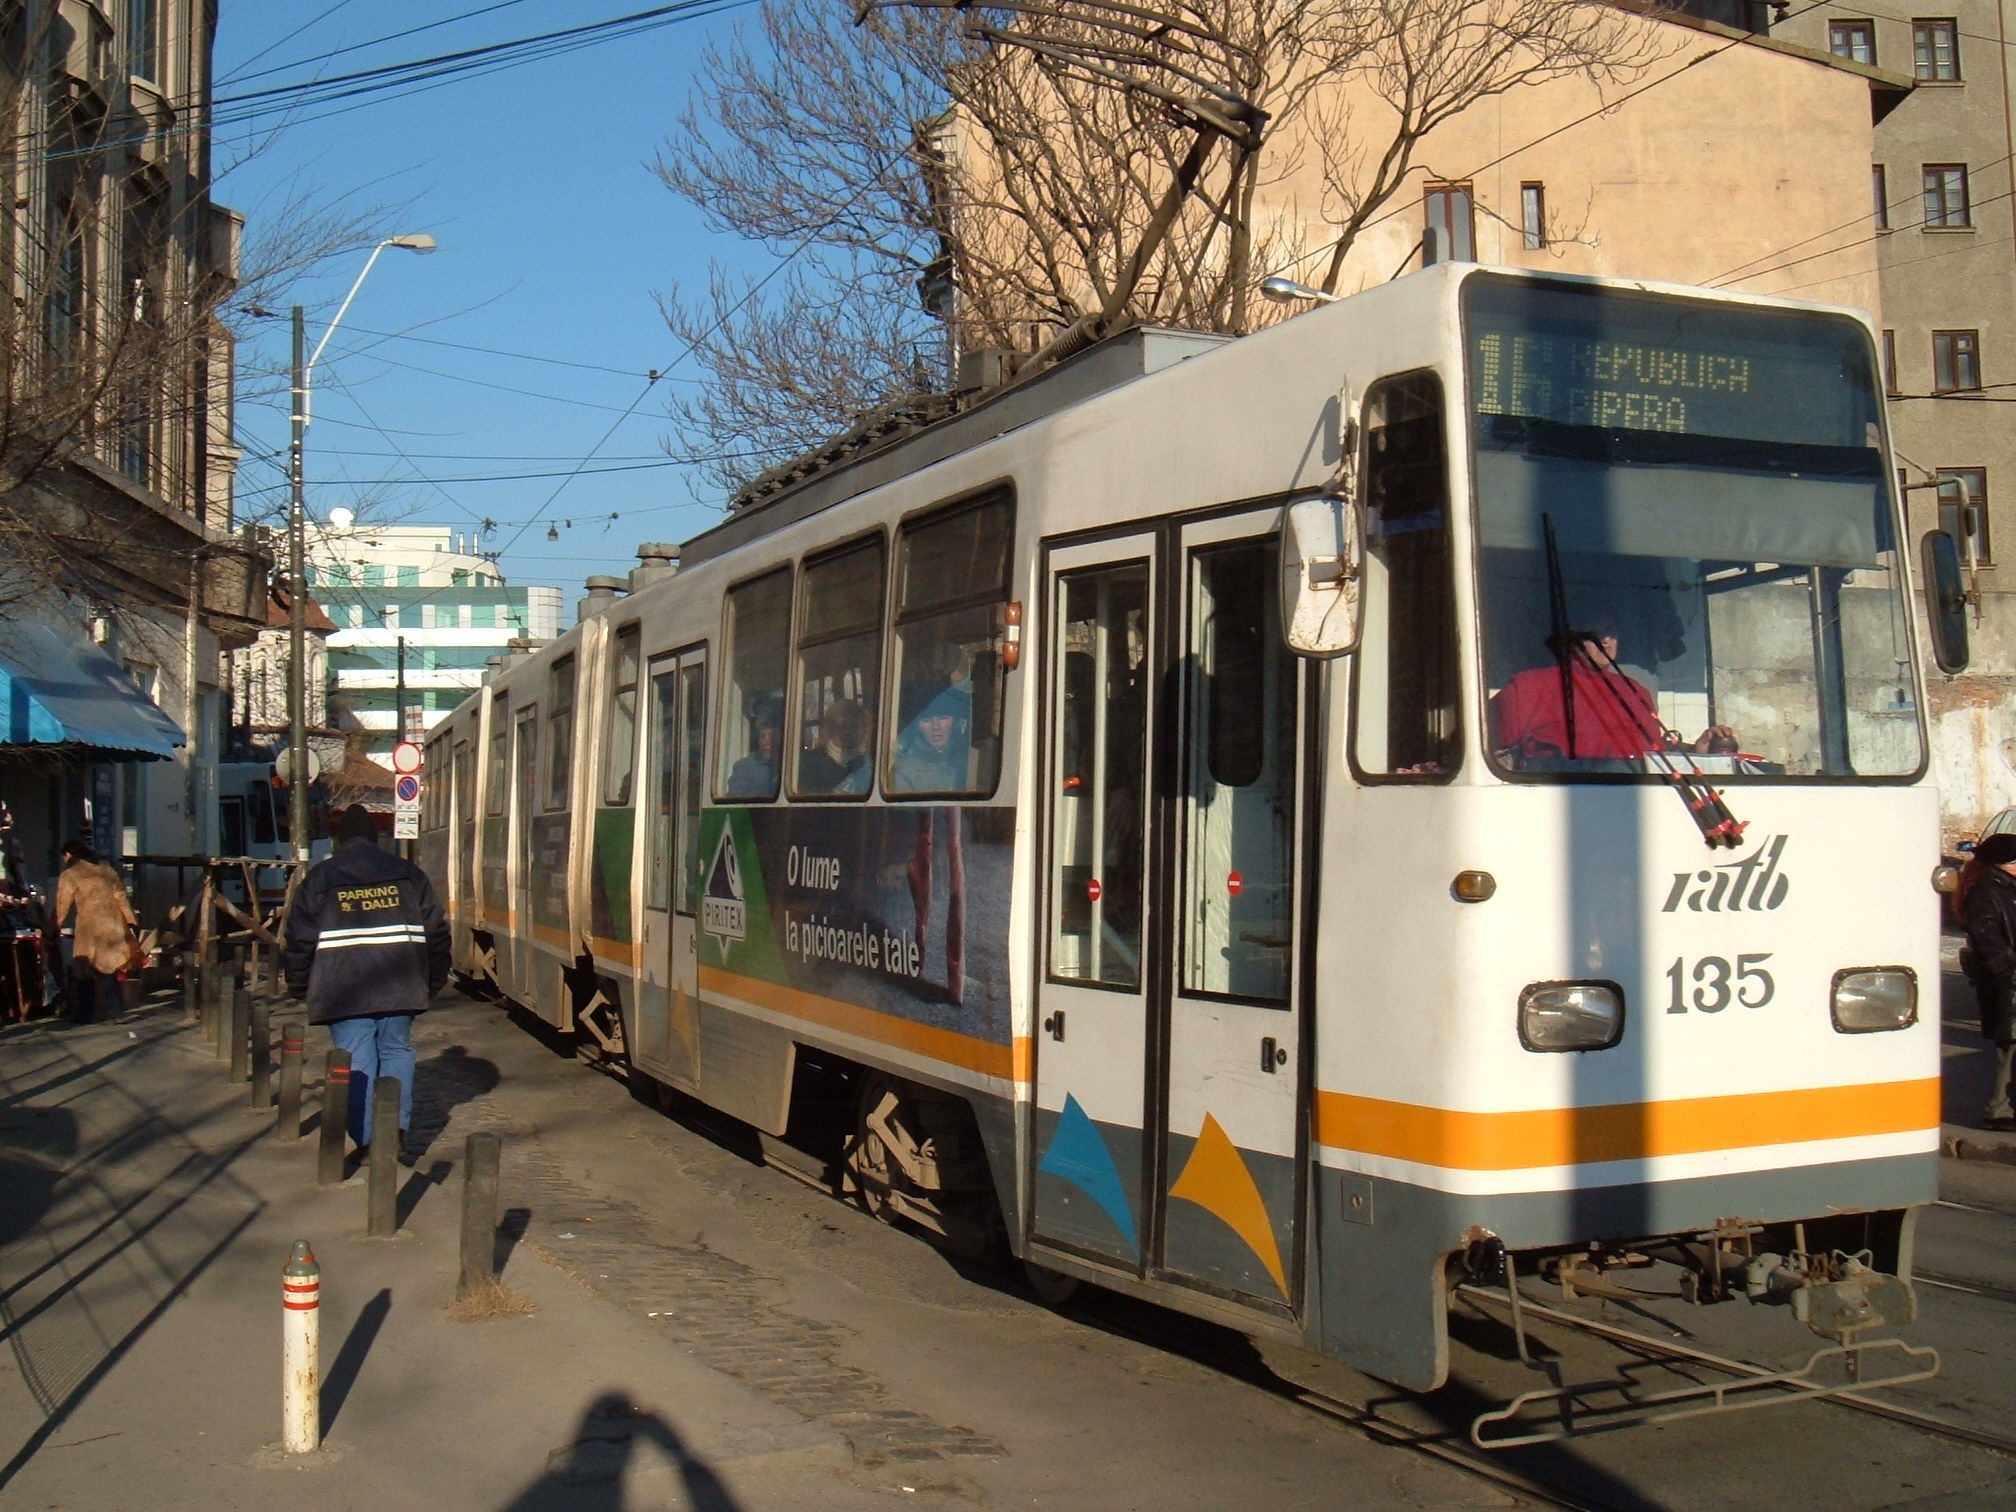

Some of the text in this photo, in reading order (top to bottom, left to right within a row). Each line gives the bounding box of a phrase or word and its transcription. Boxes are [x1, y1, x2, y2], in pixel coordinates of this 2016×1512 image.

[801, 846, 841, 891] lume
[337, 885, 399, 901] PARKING
[361, 897, 400, 911] DALLI
[703, 902, 744, 932] PIRITEX
[785, 910, 922, 978] la picioarele tale
[1666, 953, 1775, 1014] 135
